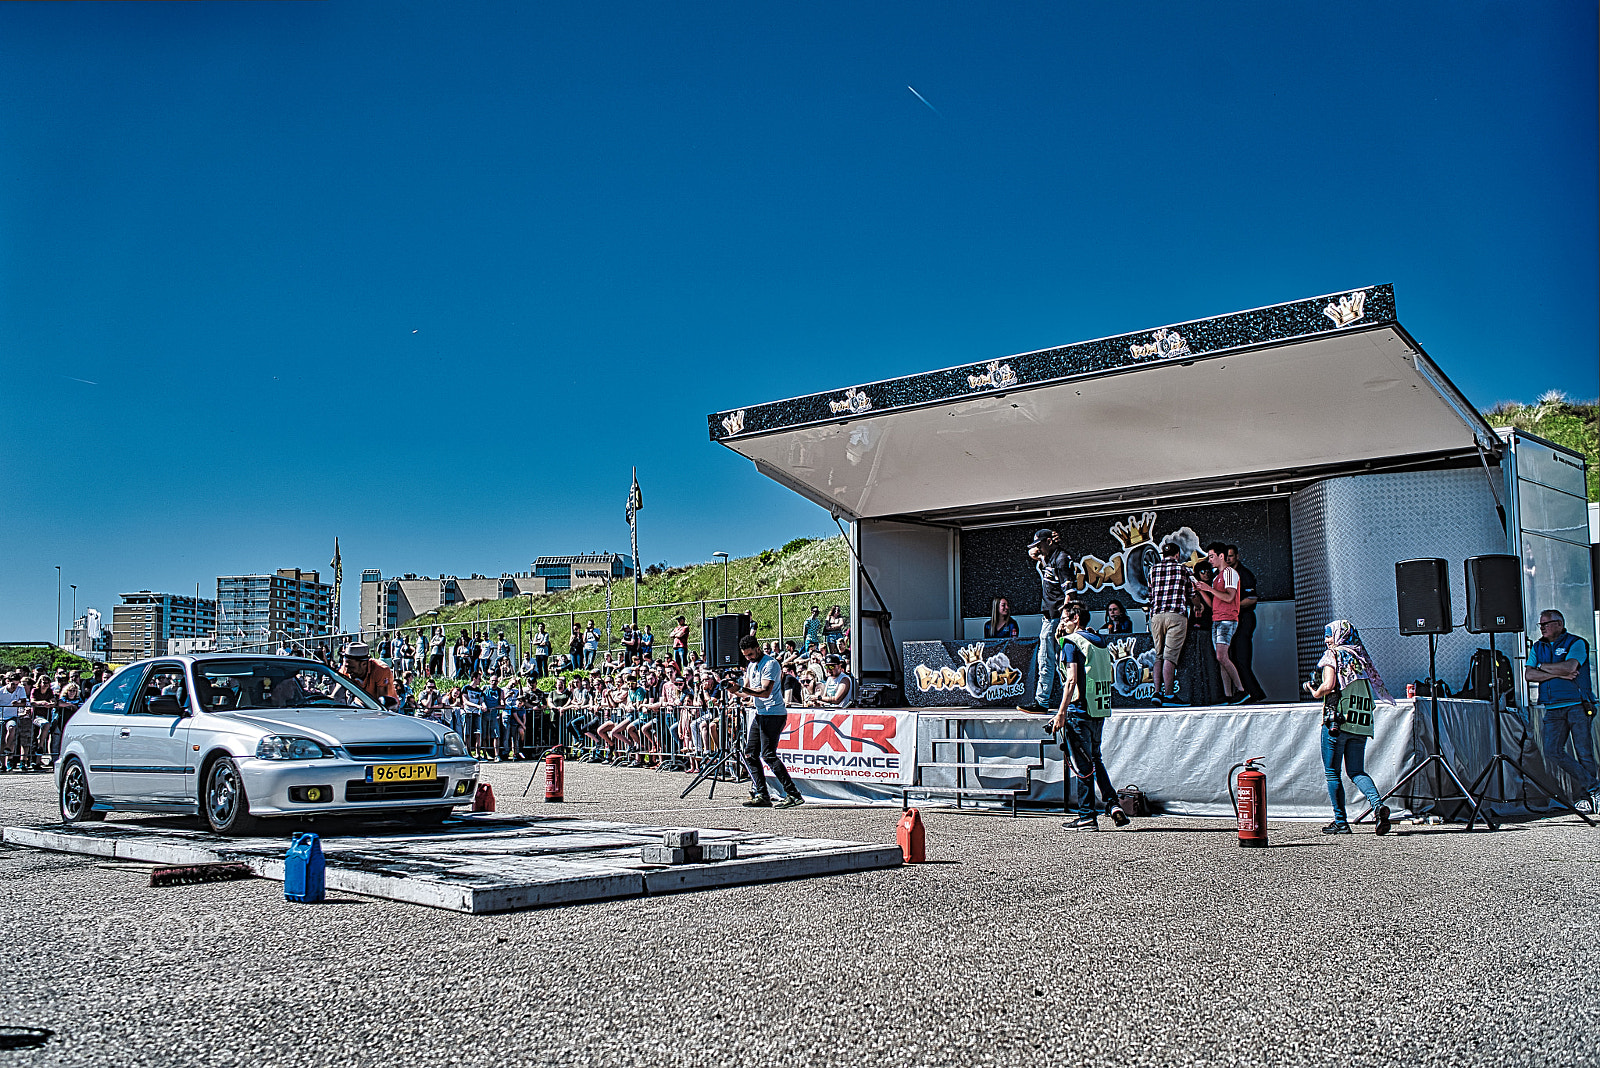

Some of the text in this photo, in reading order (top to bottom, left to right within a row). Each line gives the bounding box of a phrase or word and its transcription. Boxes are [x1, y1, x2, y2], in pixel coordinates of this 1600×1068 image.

[987, 682, 1024, 700] MADNESS
[776, 752, 900, 769] RFORMANCE
[376, 765, 432, 780] 96-GJ-PV
